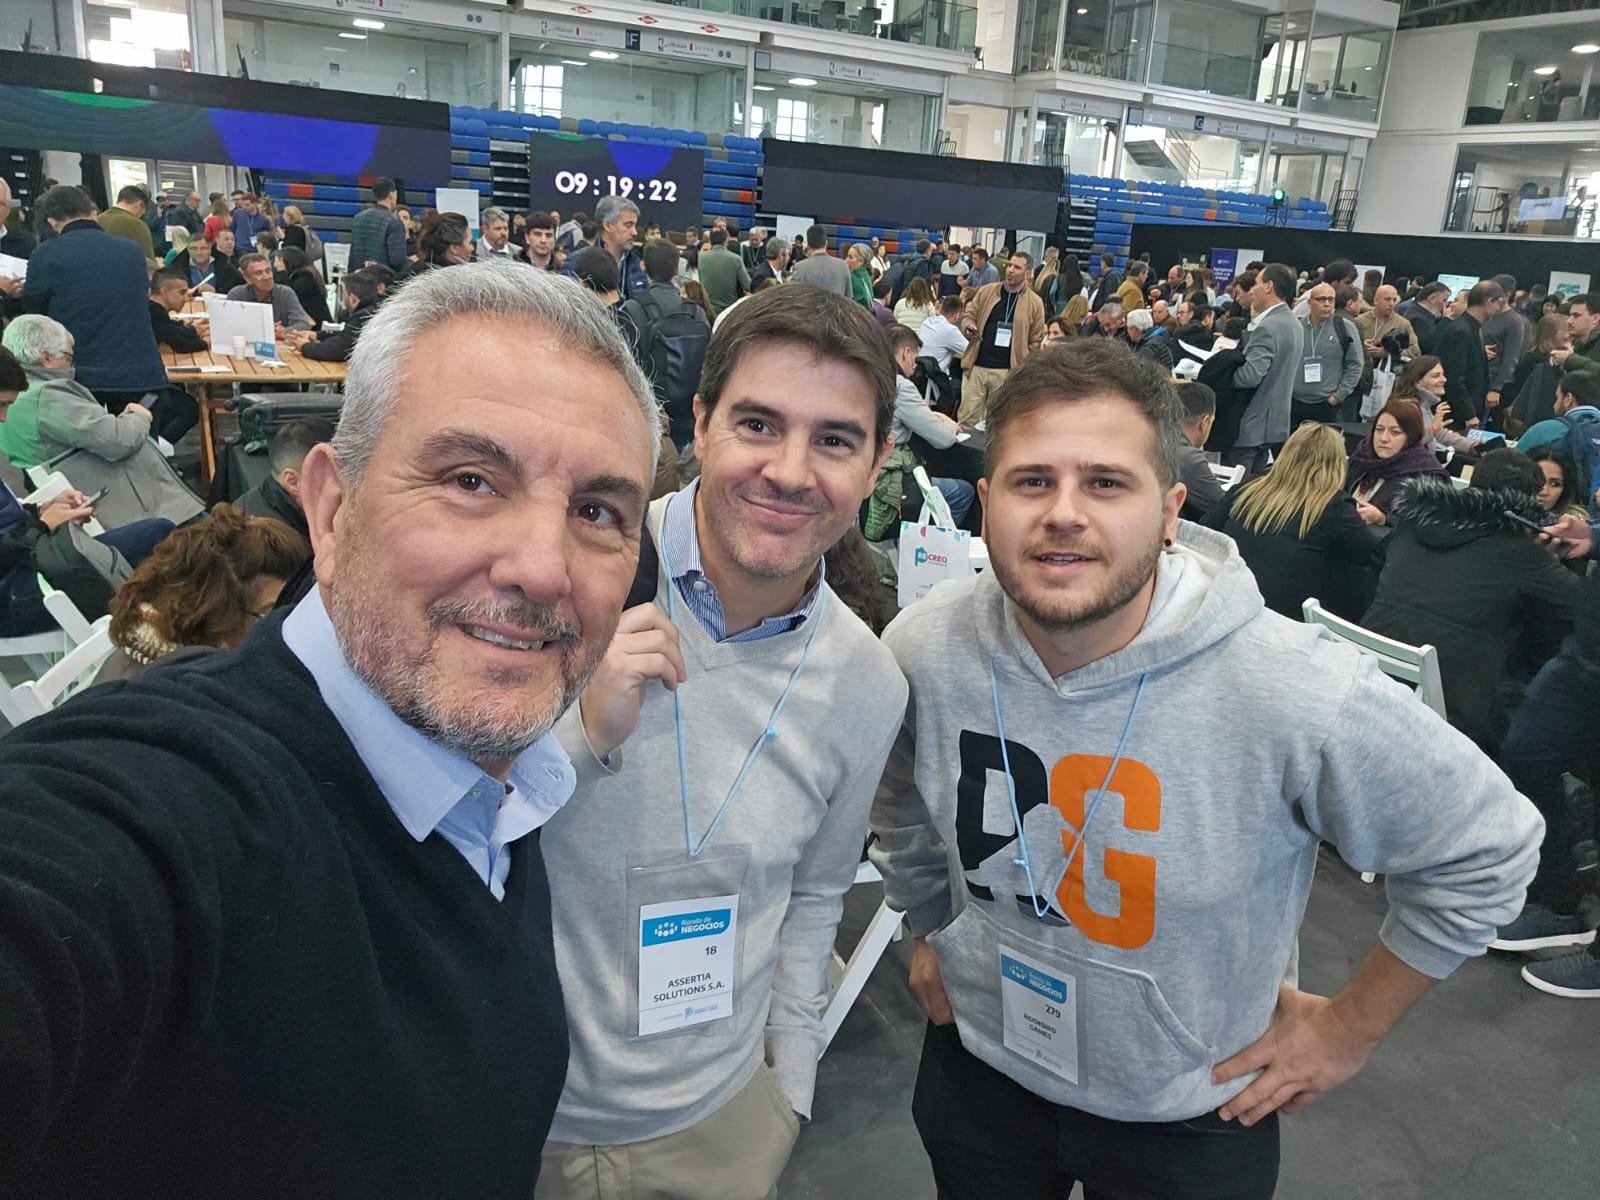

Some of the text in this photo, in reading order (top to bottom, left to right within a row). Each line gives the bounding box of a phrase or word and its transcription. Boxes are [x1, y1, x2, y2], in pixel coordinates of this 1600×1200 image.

[630, 33, 639, 47] F
[681, 918, 702, 926] Ronda
[681, 921, 725, 934] NEGOCIOS
[705, 946, 717, 956] 18
[667, 972, 712, 988] ASSERTIA
[653, 981, 725, 1003] SOLUTIONS S.A.
[1045, 1004, 1061, 1018] 279
